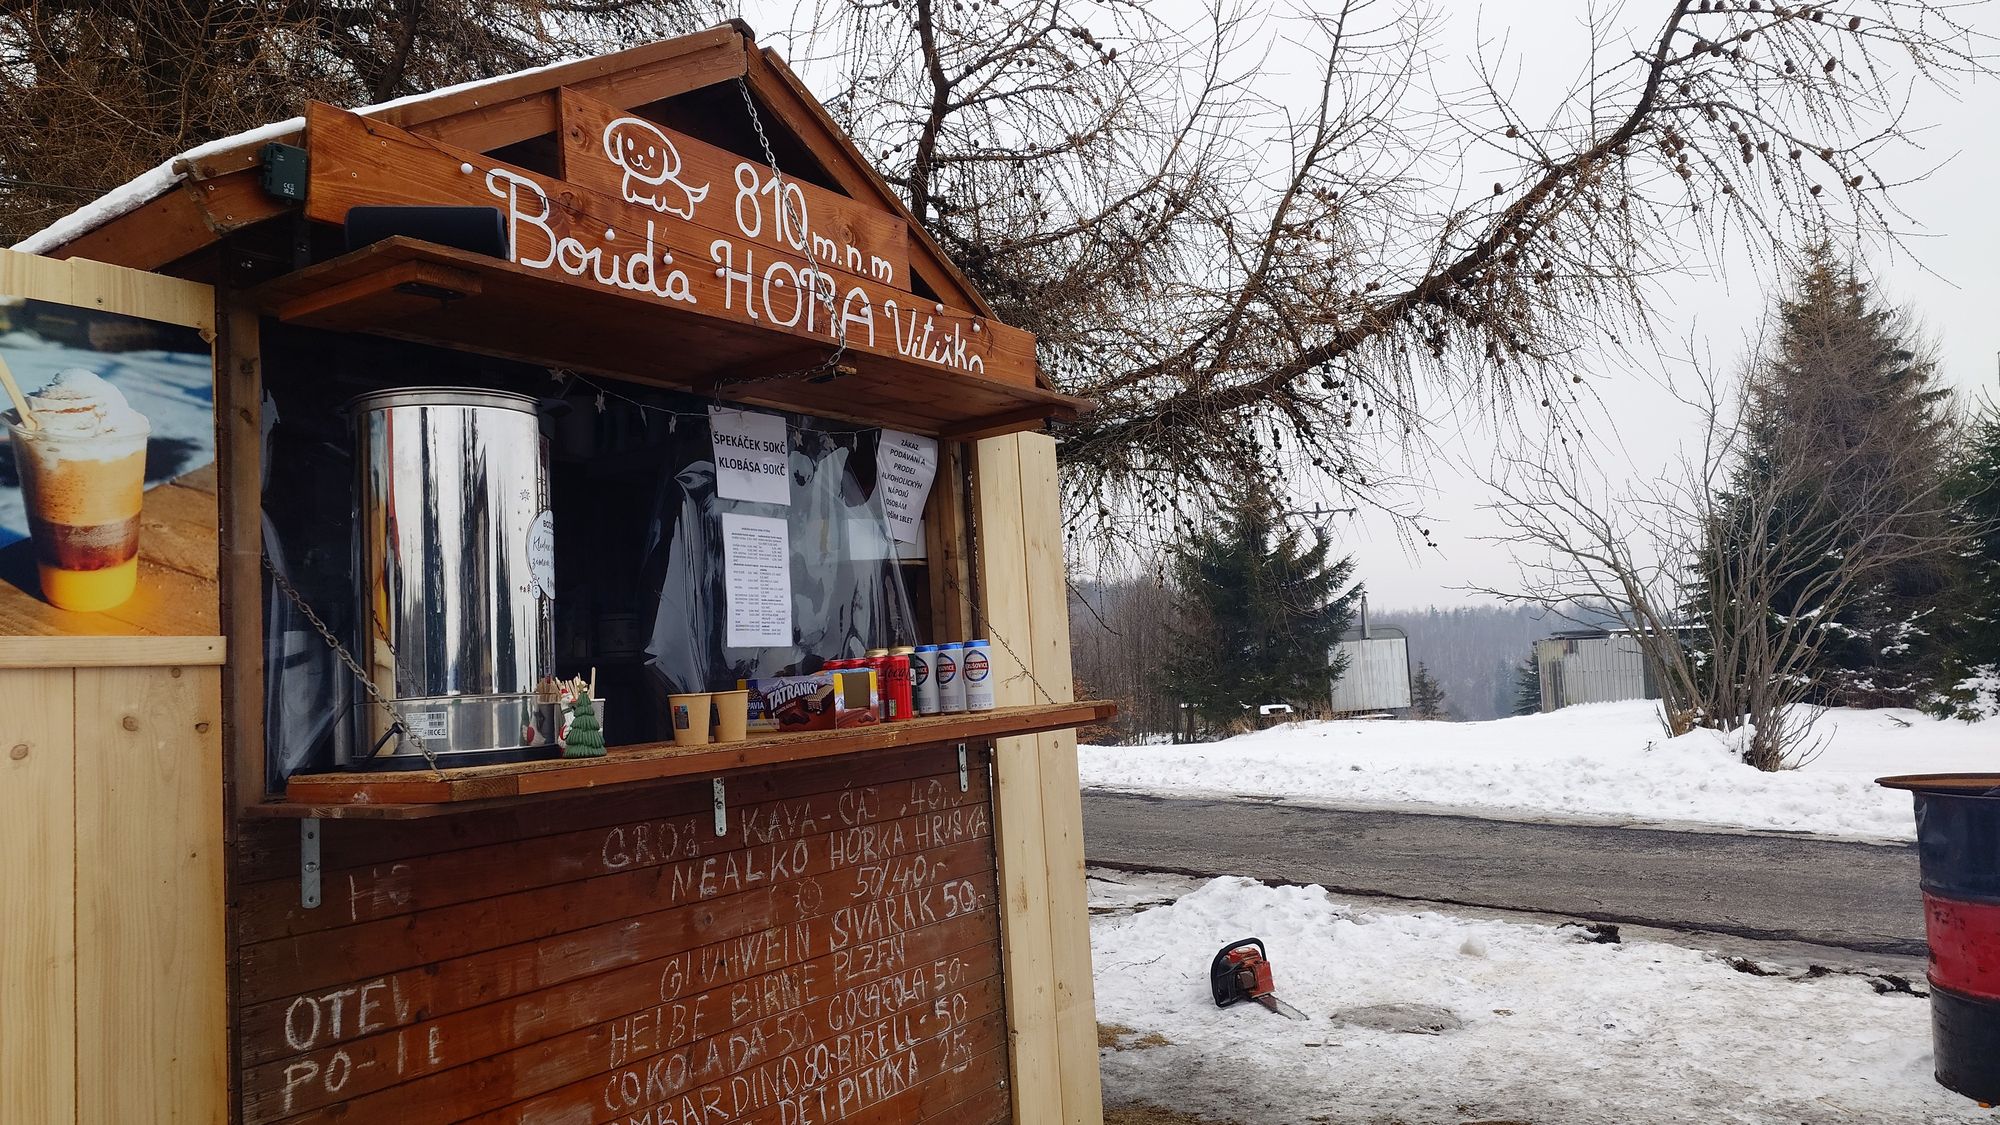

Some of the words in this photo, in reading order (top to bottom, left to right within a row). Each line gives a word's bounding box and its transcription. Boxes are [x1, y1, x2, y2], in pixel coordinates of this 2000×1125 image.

[735, 162, 808, 250] 810
[486, 168, 697, 304] Bouda
[710, 239, 874, 347] HORA
[714, 431, 761, 451] ŠPEKÁČEK
[763, 441, 785, 454] 50KČ
[901, 439, 919, 451] ZÁKAZ
[718, 456, 761, 473] KLOBÁSA
[763, 463, 786, 476] 90KČ
[893, 462, 916, 475] PRODEJ
[747, 701, 765, 710] PAVIA
[767, 682, 818, 711] TATRANKY
[671, 839, 808, 904] NEALKO
